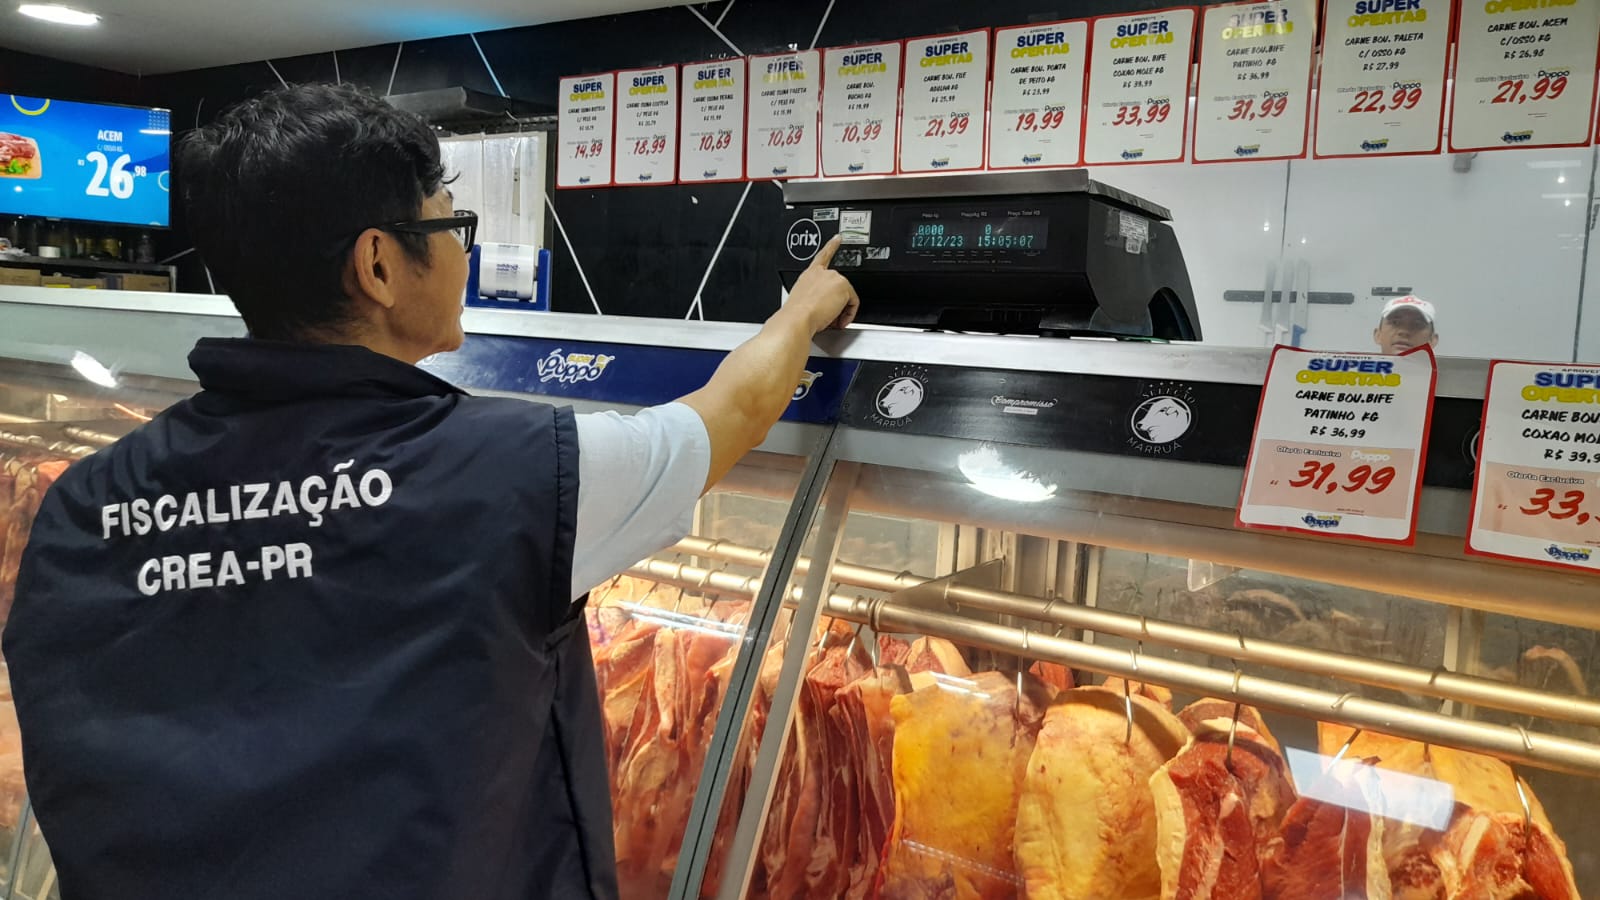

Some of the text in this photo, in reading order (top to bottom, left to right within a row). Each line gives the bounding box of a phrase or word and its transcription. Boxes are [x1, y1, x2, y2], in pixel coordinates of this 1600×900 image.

[1356, 0, 1420, 14] SUPER
[1348, 8, 1427, 28] OFERTAS
[1488, 22, 1516, 32] CARNE
[1542, 18, 1568, 27] ACEM
[1117, 20, 1168, 37] SUPER
[1017, 32, 1064, 48] SUPER
[1345, 36, 1371, 46] CARNE
[1394, 32, 1424, 42] PALETA
[1538, 34, 1552, 42] KG
[926, 42, 968, 57] SUPER
[1011, 42, 1070, 58] OFERTAS
[1226, 48, 1250, 56] CARNE
[1358, 48, 1406, 58] C/ OSSO KG
[843, 52, 882, 66] SUPER
[920, 52, 972, 68] OFERTAS
[1113, 56, 1134, 65] CARNE
[1152, 54, 1167, 62] BIFE
[1232, 60, 1263, 68] PATINHO
[698, 68, 730, 80] SUPER
[1010, 66, 1030, 74] CARNE
[574, 82, 602, 92] SUPER
[633, 75, 664, 87] SUPER
[1491, 76, 1568, 104] 21,99
[1228, 96, 1288, 121] 31,99
[1348, 88, 1422, 114] 22,99
[1016, 111, 1064, 132] 19,99
[1112, 104, 1170, 127] 33,99
[842, 124, 881, 143] 10,99
[925, 117, 968, 137] 21,99
[98, 130, 122, 142] ACEM
[699, 134, 731, 152] 10,69
[768, 130, 802, 147] 10,69
[575, 142, 602, 158] 14,99
[634, 139, 666, 154] 18,99
[790, 230, 818, 249] prix
[912, 236, 1034, 248] 12/12/23 15:05:07
[1308, 358, 1394, 374] SUPER
[1296, 370, 1400, 387] OFERTAS
[991, 395, 1057, 408] Compromisso
[1296, 390, 1335, 402] CARNE
[1304, 408, 1379, 422] PATINHO KG
[1522, 409, 1568, 422] CARNE
[1310, 426, 1328, 436] R$
[1522, 428, 1570, 442] COXAO
[1544, 448, 1564, 460] R$
[1288, 460, 1396, 494] 31,99
[1507, 471, 1584, 484] Oferta Exclusiva
[102, 459, 393, 540] FISCALIZAÇÃO
[1520, 488, 1600, 525] 33,
[138, 542, 313, 596] CREA-PR
